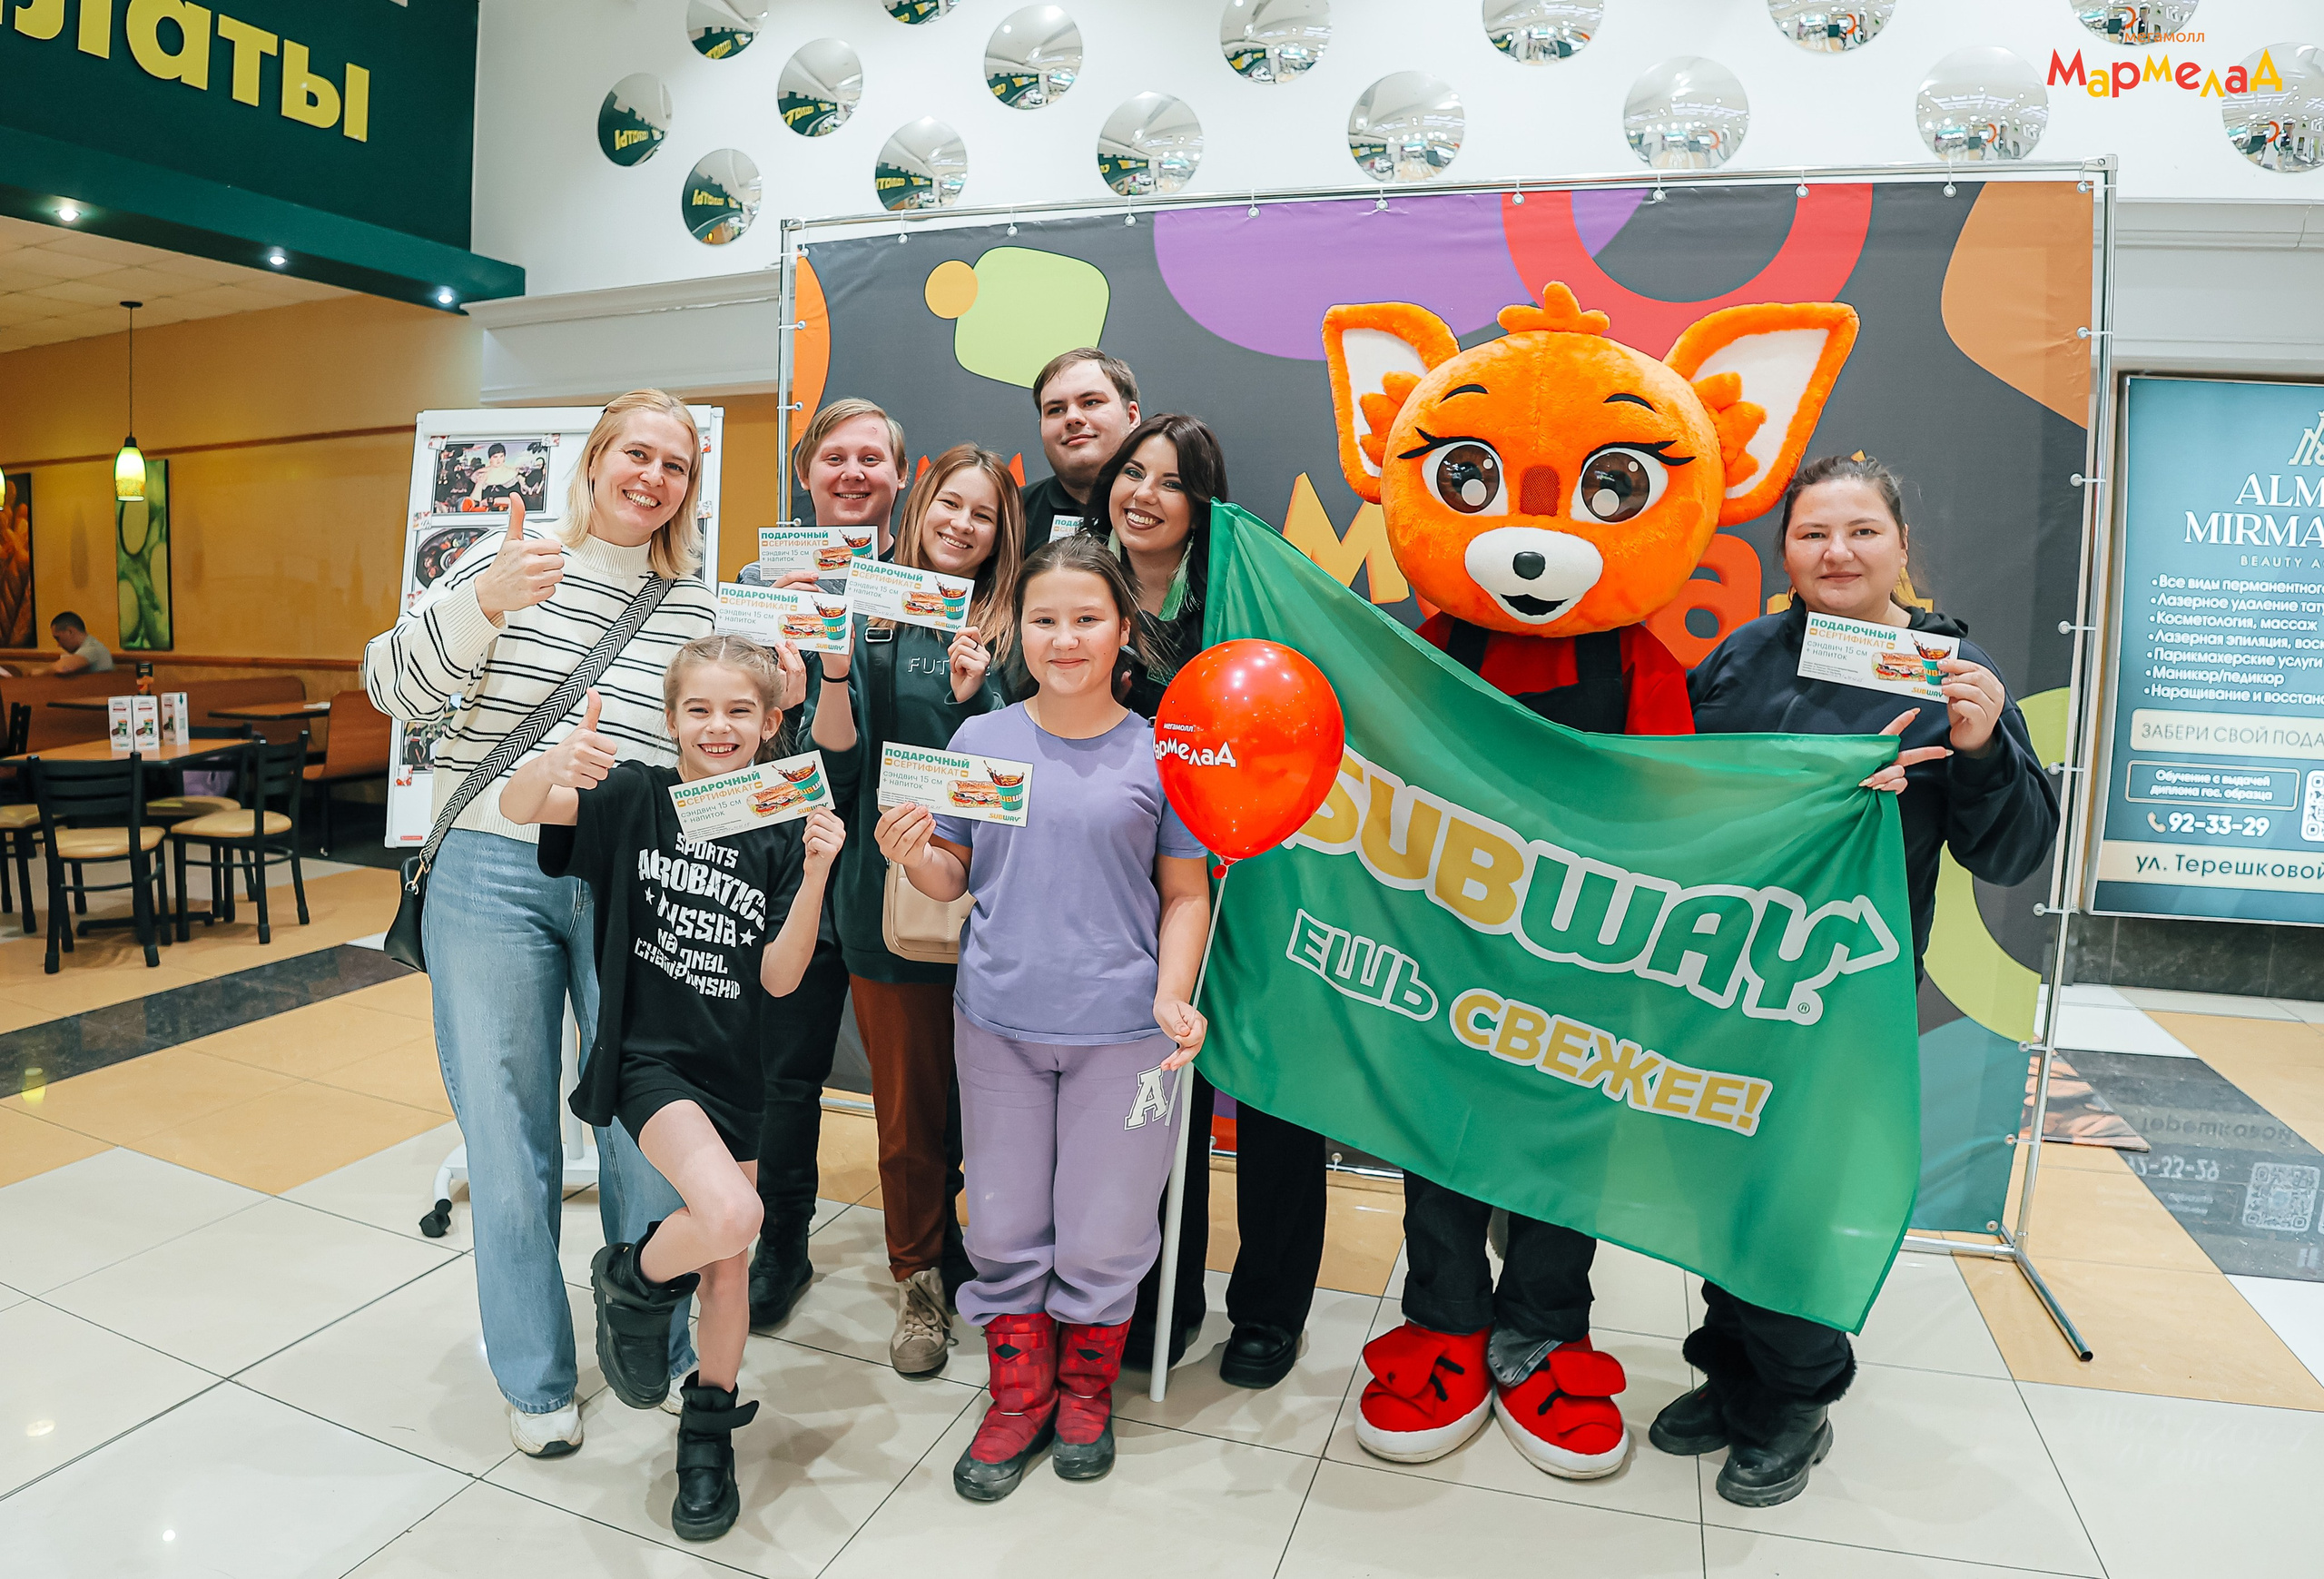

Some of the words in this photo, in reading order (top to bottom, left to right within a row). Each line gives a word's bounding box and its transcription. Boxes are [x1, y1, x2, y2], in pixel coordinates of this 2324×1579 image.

[0, 0, 370, 143] латы
[761, 530, 829, 539] ПОДАРОЧНЫЙ
[2183, 510, 2324, 548] MIRMA
[2240, 555, 2303, 568] BEAUTY
[2310, 558, 2324, 569] A
[852, 562, 923, 582] ПОДАРОЧНЫЙ
[859, 570, 914, 588] СЕРТИФИКАТ
[849, 581, 879, 591] сэндвич
[853, 587, 882, 598] напиток
[2159, 574, 2185, 588] Все
[2188, 577, 2221, 590] виды
[2222, 579, 2324, 594] перманентног
[721, 587, 798, 603] ПОДАРОЧНЫЙ
[729, 597, 789, 611] СЕРТИФИКАТ
[2157, 592, 2229, 610] Лазерное
[2231, 599, 2299, 613] удаление
[719, 608, 752, 617] сэндвич
[724, 616, 756, 625] напиток
[2156, 611, 2257, 630] Косметология,
[2260, 618, 2319, 632] массаж
[933, 620, 961, 629] SUBWAY
[1811, 618, 1897, 641] ПОДАРОЧНЫЙ
[815, 643, 844, 651] SUBWAY
[1807, 640, 1843, 652] сэндвич
[1846, 646, 1854, 655] 15
[1818, 630, 1886, 649] СЕРТИФИКАТ
[2155, 628, 2224, 646] Лазерная
[2226, 636, 2291, 649] эпиляция,
[1812, 648, 1847, 661] напиток
[2153, 646, 2275, 666] Парикмахерские
[2278, 656, 2322, 670] услуги
[2152, 665, 2284, 686] Маникюр/педикюр
[1911, 687, 1943, 697] SUBWAY
[2152, 683, 2251, 701] Наращивание
[2252, 691, 2262, 703] и
[1164, 723, 1194, 732] мегамолл
[2141, 723, 2209, 740] ЗАБЕРИ
[2213, 726, 2268, 745] СВОЙ
[884, 747, 970, 769] ПОДАРОЧНЫЙ
[1153, 734, 1236, 768] армелаД
[883, 771, 918, 781] сэндвич
[893, 759, 960, 776] СЕРТИФИКАТ
[674, 771, 761, 799] ПОДАРОЧНЫЙ
[890, 779, 923, 789] напиток
[2155, 769, 2211, 785] Обучение
[2212, 775, 2221, 784] с
[2221, 774, 2270, 787] выдачей
[686, 784, 753, 806] СЕРТИФИКАТ
[2150, 785, 2199, 797] диплома
[2201, 787, 2222, 797] гос.
[2224, 788, 2272, 801] образца
[681, 805, 717, 818] сэндвич
[718, 801, 728, 809] 15
[690, 810, 725, 824] напиток
[989, 813, 1021, 822] SUBWAY
[2168, 812, 2270, 837] 92-33-29
[675, 833, 739, 868] SPORTS
[2136, 854, 2168, 873] ул.
[1282, 746, 1899, 1024] SUBWAY
[1286, 908, 1438, 1021] ЕШЬ
[1450, 988, 1773, 1136] СВЕЖЕЕ!
[1124, 1065, 1168, 1130] A
